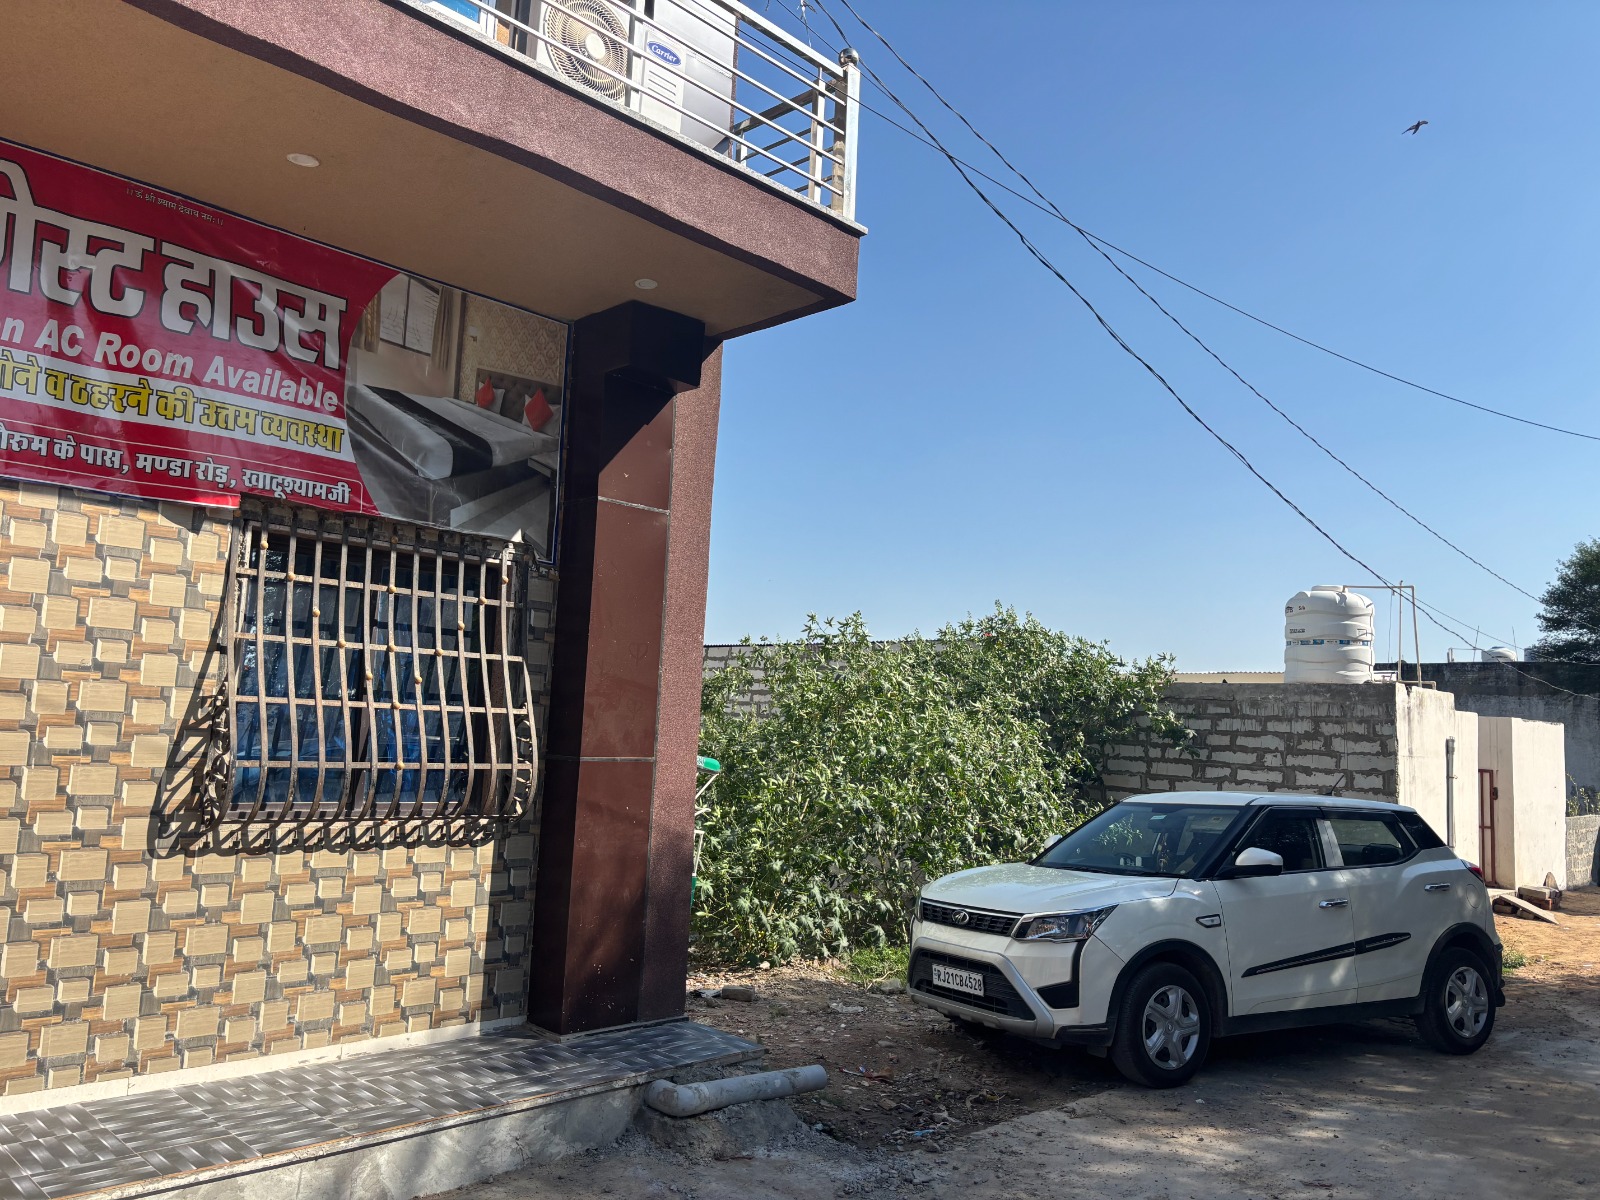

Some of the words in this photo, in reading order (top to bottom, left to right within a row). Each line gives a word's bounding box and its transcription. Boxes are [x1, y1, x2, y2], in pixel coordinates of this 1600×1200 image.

[651, 44, 677, 62] Carrier
[145, 192, 156, 203] श्री
[157, 198, 177, 210] श्याम
[178, 202, 199, 217] देवाय
[160, 240, 347, 370] हाउस
[0, 317, 25, 344] n
[34, 318, 85, 357] AC
[94, 331, 194, 379] Room
[202, 355, 339, 412] Available
[0, 349, 43, 396] ोने
[45, 367, 69, 401] व
[71, 378, 153, 416] ठहरने
[156, 386, 198, 424] की
[199, 398, 259, 435] उत्तम
[261, 410, 345, 453] व्यवस्था
[52, 435, 77, 460] के
[80, 443, 131, 474] पास,
[135, 453, 193, 478] मण्डा
[195, 457, 238, 489] रोड़,
[937, 968, 983, 992] RJ21CB4528
